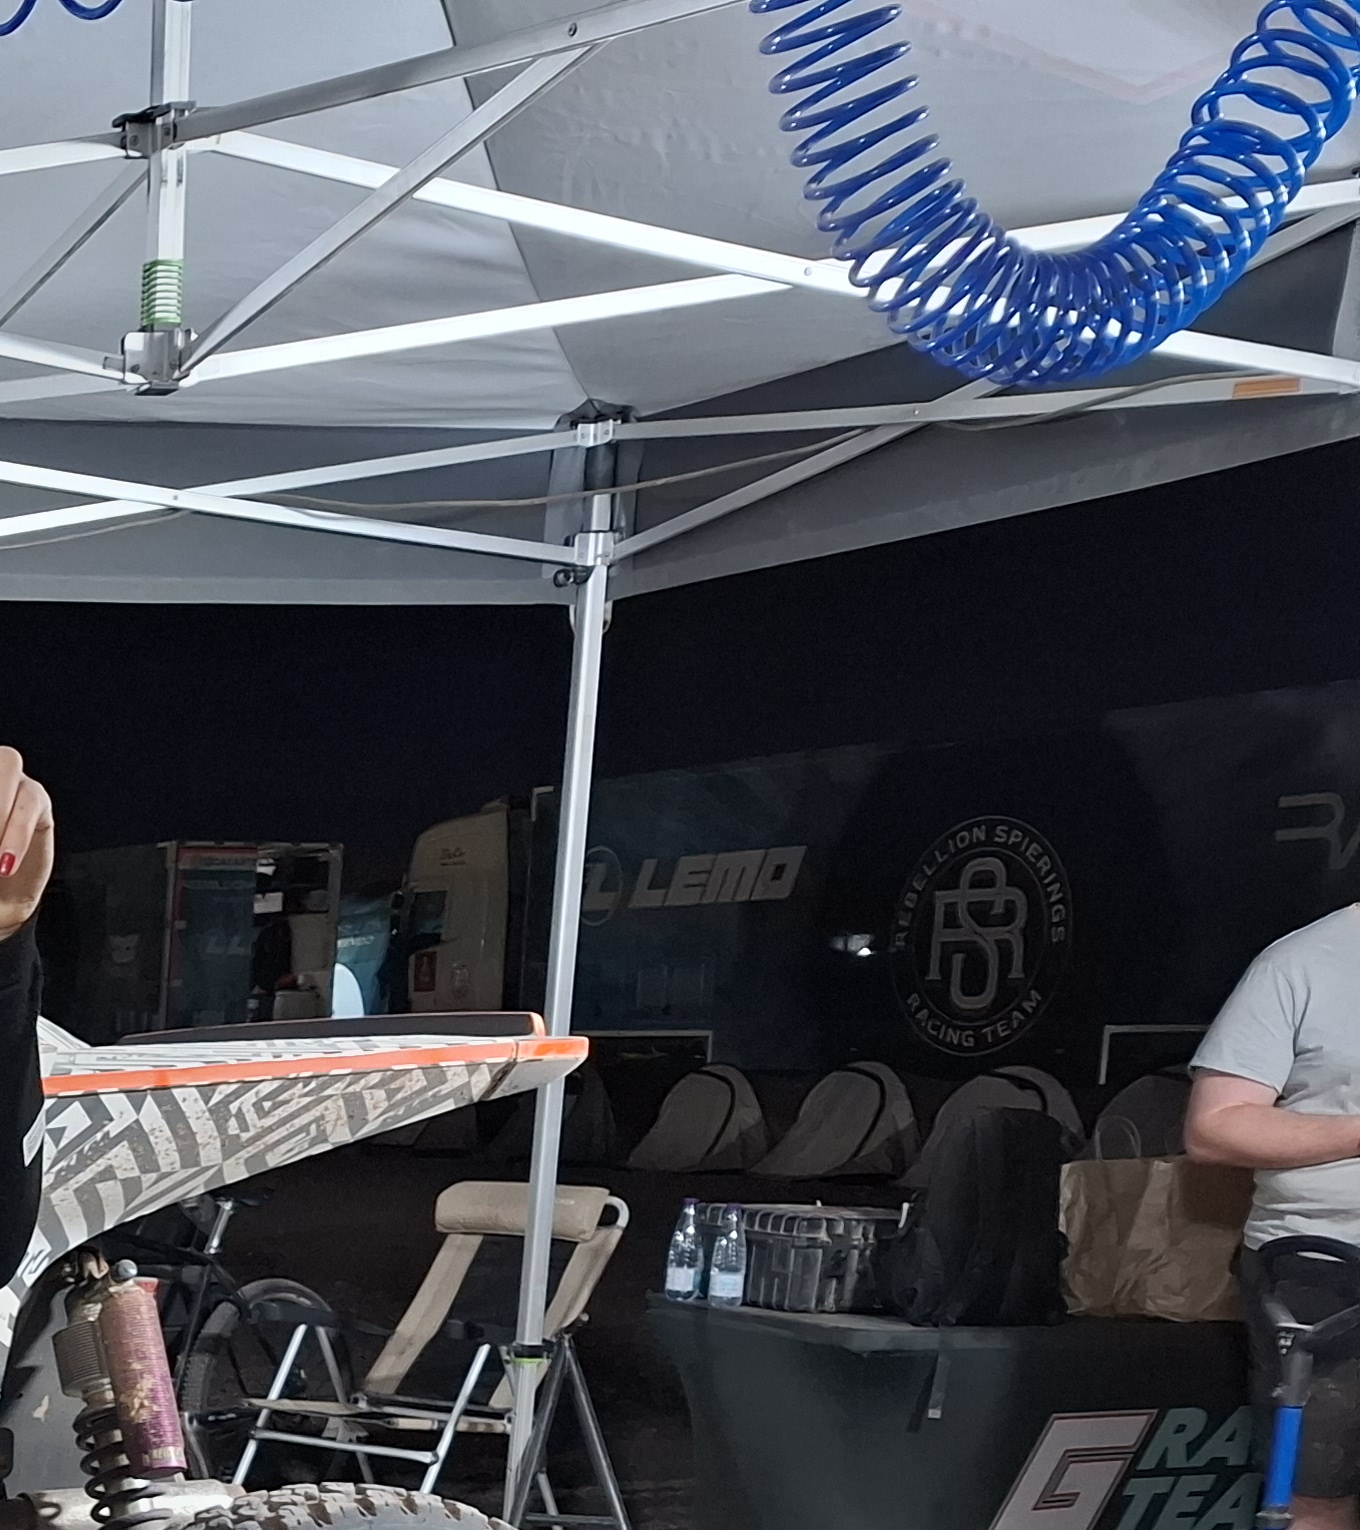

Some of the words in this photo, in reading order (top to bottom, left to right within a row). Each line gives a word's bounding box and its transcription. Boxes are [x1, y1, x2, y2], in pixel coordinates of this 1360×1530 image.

[628, 846, 807, 909] LEMO
[907, 993, 975, 1047] RACING
[981, 989, 1042, 1042] TEAM
